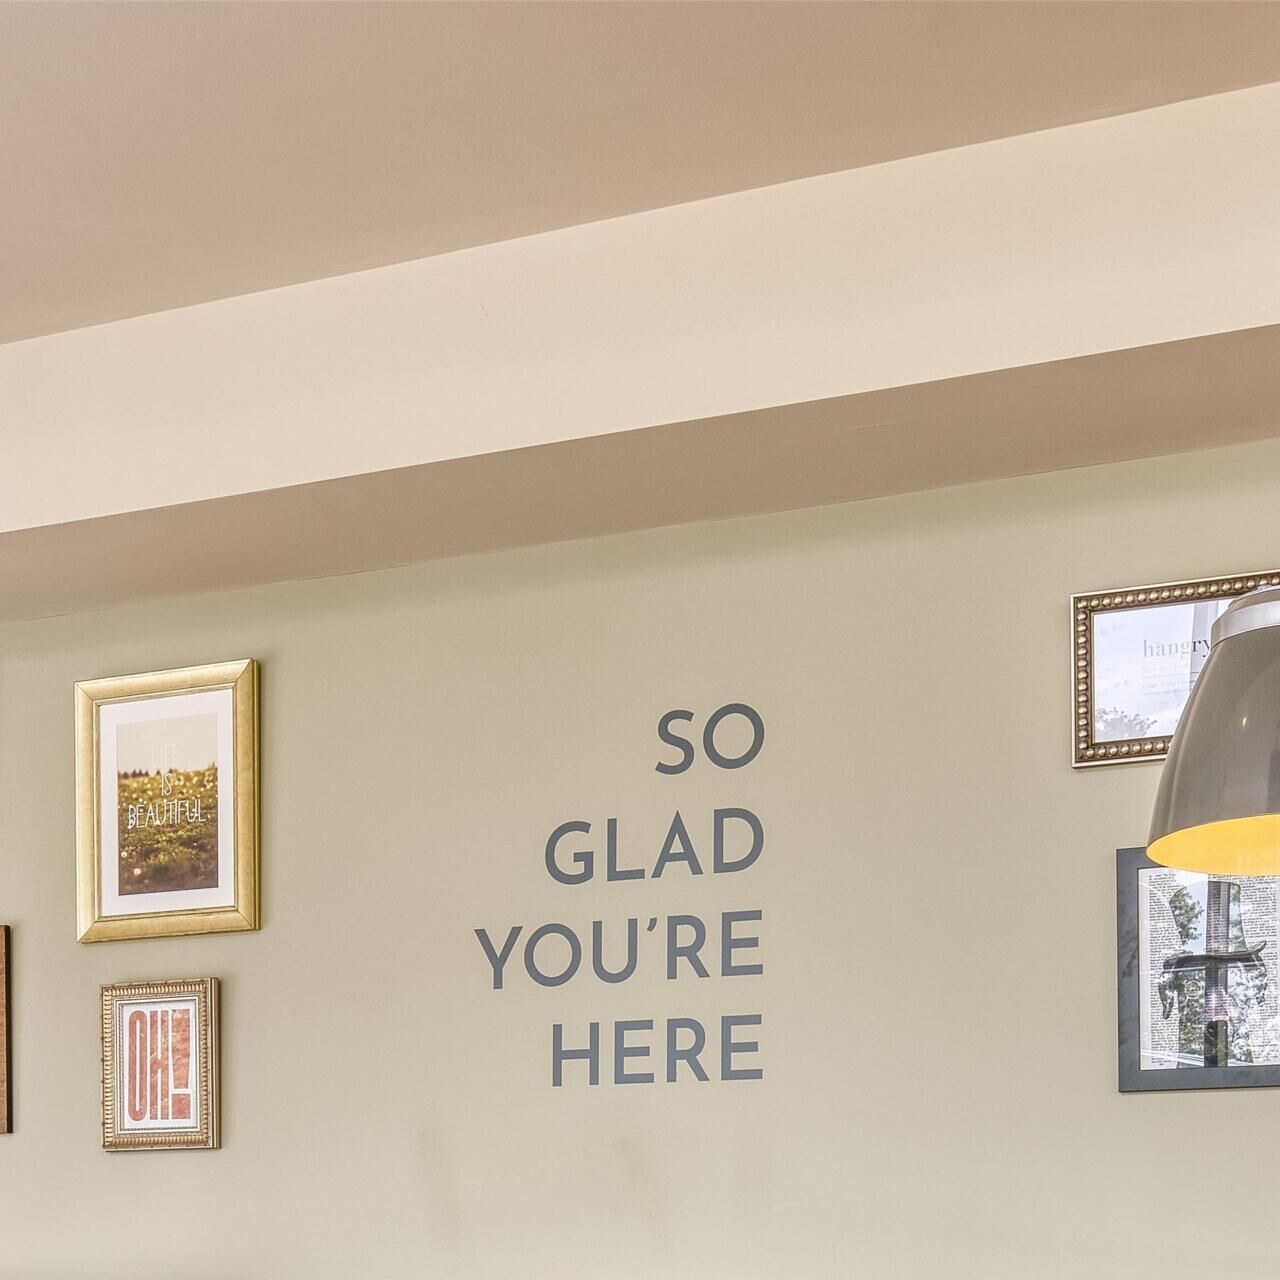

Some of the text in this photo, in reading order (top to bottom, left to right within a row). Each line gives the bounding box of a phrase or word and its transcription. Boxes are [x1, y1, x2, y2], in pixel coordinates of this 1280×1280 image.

[152, 742, 183, 769] LIFE
[654, 702, 766, 776] SO
[127, 798, 207, 830] BEAUTIFUL
[160, 773, 173, 796] IS
[544, 807, 765, 886] GLAD
[473, 909, 764, 990] YOU'RE
[128, 1009, 191, 1121] OH!
[552, 1014, 764, 1088] HERE
